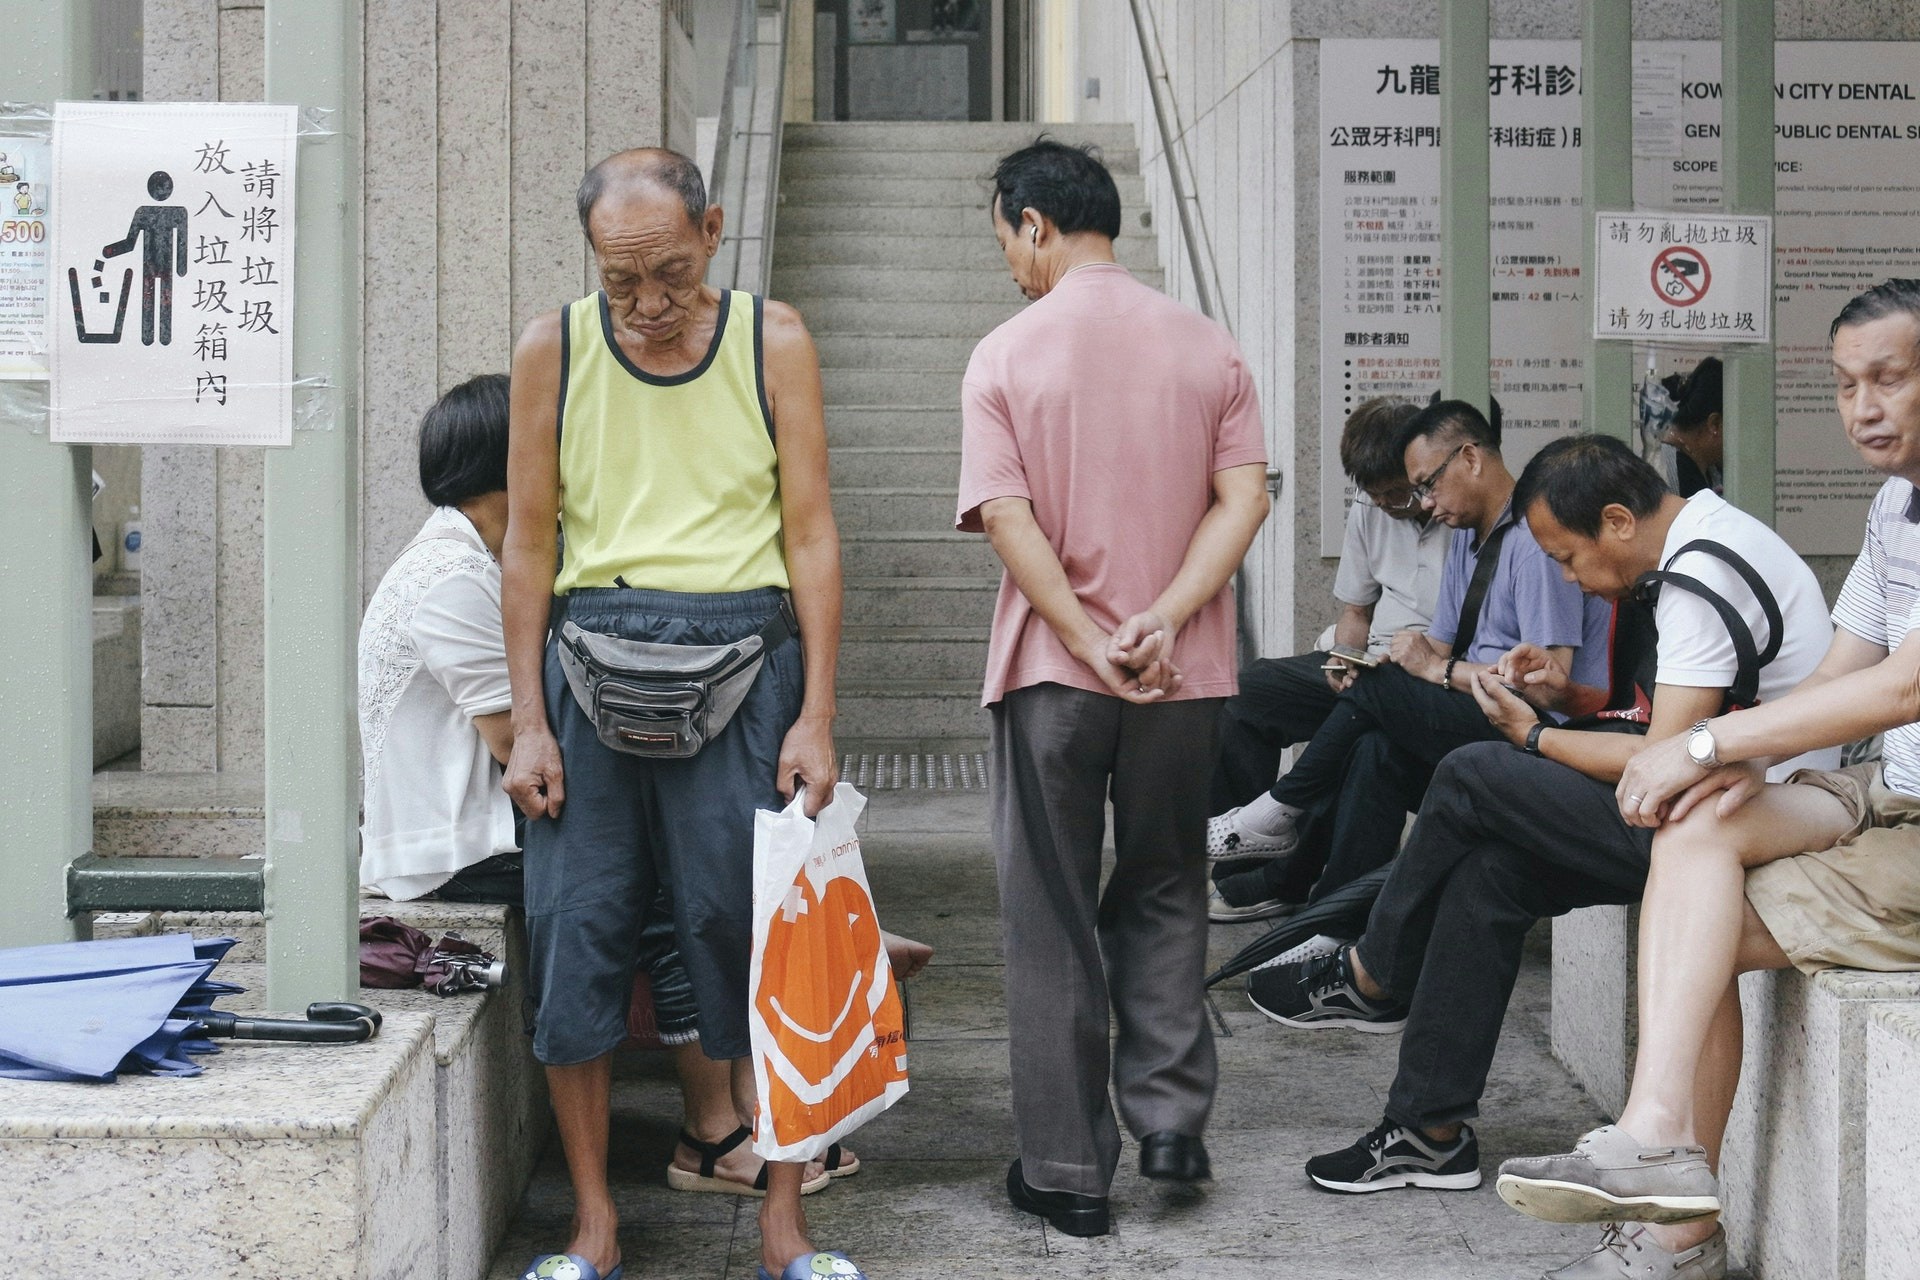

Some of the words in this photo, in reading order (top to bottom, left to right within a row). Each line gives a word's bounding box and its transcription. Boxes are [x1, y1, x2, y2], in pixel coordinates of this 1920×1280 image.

[1789, 83, 1833, 100] CITY
[1839, 83, 1916, 100] DENTAL
[1774, 124, 1832, 139] PUBLIC
[1837, 125, 1902, 139] DENTAL
[1673, 160, 1718, 172] SCOPE
[1344, 170, 1396, 184] 服務範圍
[1807, 185, 1835, 194] including
[238, 159, 281, 335] 請將垃圾
[1803, 246, 1834, 255] Thursday
[1836, 246, 1865, 255] Morning
[1893, 246, 1914, 254] Public
[191, 139, 235, 406] 放入垃圾箱內
[1831, 271, 1856, 279] Waiting
[1819, 284, 1850, 292] Thursday
